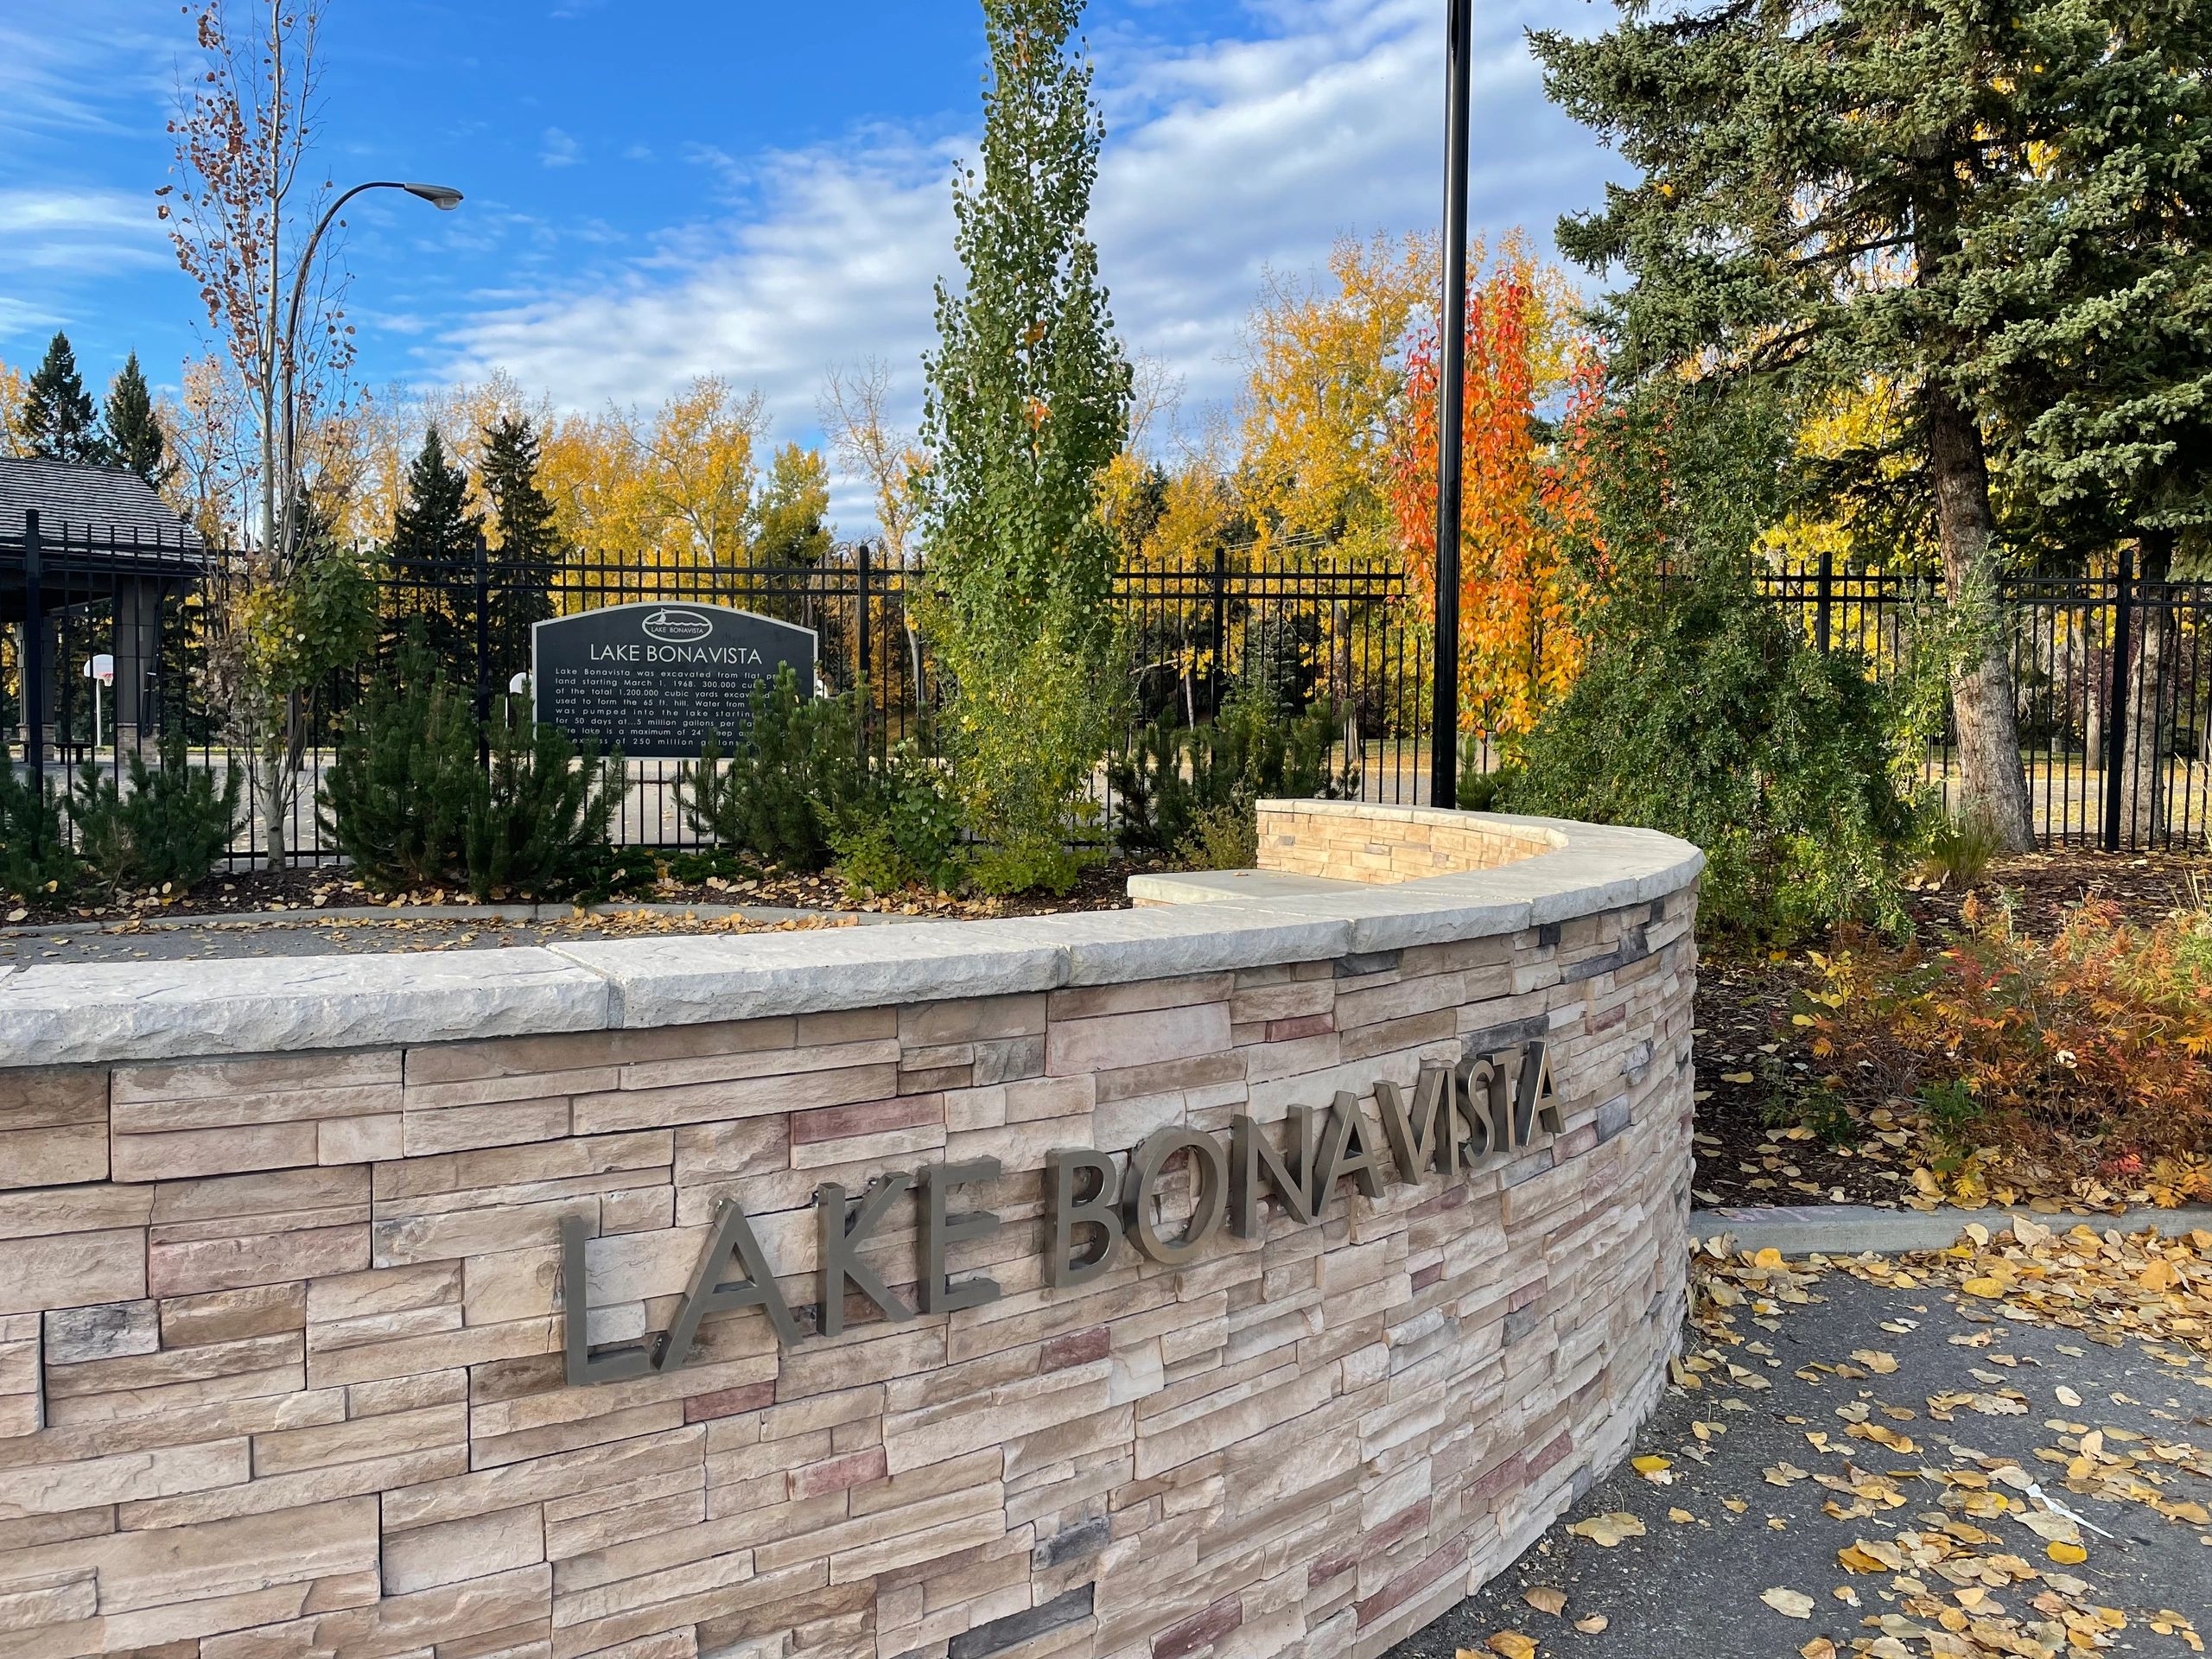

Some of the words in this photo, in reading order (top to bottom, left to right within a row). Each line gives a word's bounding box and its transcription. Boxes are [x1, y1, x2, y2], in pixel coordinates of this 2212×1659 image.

[590, 644, 640, 662] LAKE
[646, 645, 762, 664] BONAVISTA
[582, 678, 617, 687] starting
[560, 1156, 1001, 1386] LAKE
[1042, 1041, 1566, 1287] BONAVISTA
